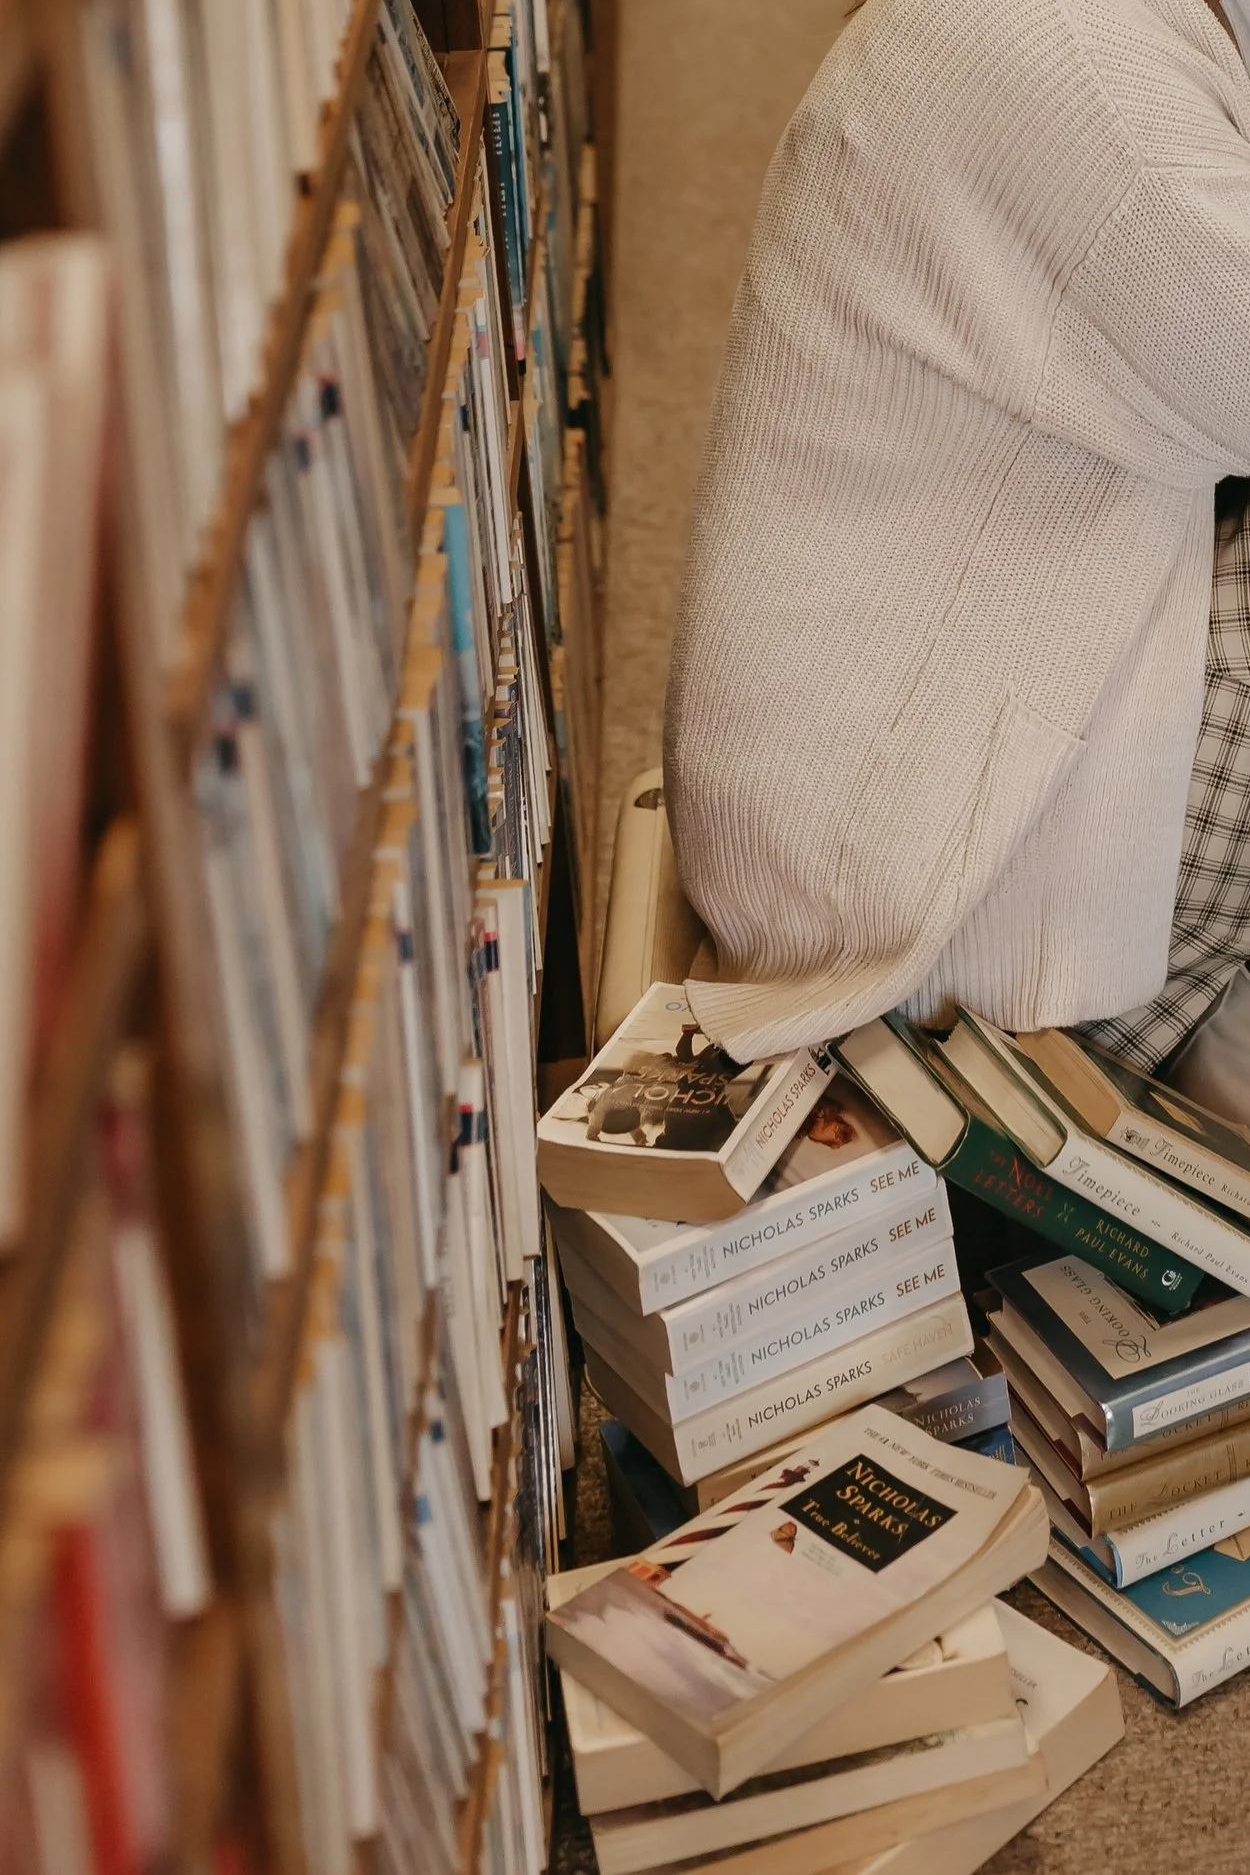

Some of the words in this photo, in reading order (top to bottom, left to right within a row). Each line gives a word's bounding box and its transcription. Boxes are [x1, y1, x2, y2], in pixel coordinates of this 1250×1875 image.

[756, 1097, 798, 1150] NICHOLAS
[790, 1062, 818, 1107] SPARKS
[870, 1171, 896, 1193] SEE
[898, 1161, 920, 1181] ME
[1008, 1155, 1053, 1201] NOEL
[1062, 1155, 1141, 1217] Timepiece
[1150, 1138, 1216, 1187] Timepiece
[974, 1169, 1045, 1218] LETTERS
[722, 1212, 804, 1259] NICHOLAS
[808, 1187, 860, 1221] SPARKS
[888, 1221, 913, 1243] SEE
[915, 1207, 937, 1227] ME
[1096, 1219, 1150, 1258] RICHARD
[748, 1265, 826, 1315] NICHOLAS
[830, 1238, 880, 1272] SPARKS
[1075, 1228, 1106, 1253] PAUL
[1109, 1249, 1150, 1280] EVANS
[1170, 1231, 1204, 1257] Richard
[1204, 1251, 1225, 1270] Paul
[1226, 1263, 1250, 1285] Evans
[896, 1276, 922, 1297] SEE
[924, 1263, 946, 1285] ME
[1060, 1265, 1092, 1296] GLASS
[751, 1317, 832, 1365] NICHOLAS
[835, 1291, 886, 1325] SPARKS
[881, 1341, 910, 1367] SAFE
[913, 1321, 954, 1353] HAVEN
[748, 1385, 822, 1429] NICHOLAS
[826, 1360, 872, 1392] SPARKS
[914, 1396, 982, 1426] NICHOLAS
[1140, 1396, 1206, 1425] LOOKING
[1210, 1379, 1244, 1399] GLASS
[925, 1413, 975, 1436] SPARKS
[836, 1484, 911, 1536] SPARKS
[846, 1461, 942, 1529] NICHOLAS
[1108, 1501, 1136, 1519] THE
[801, 1497, 830, 1527] True
[830, 1520, 882, 1561] Believer
[1134, 1548, 1159, 1569] The
[1162, 1519, 1226, 1556] Letter
[1191, 1669, 1215, 1688] The
